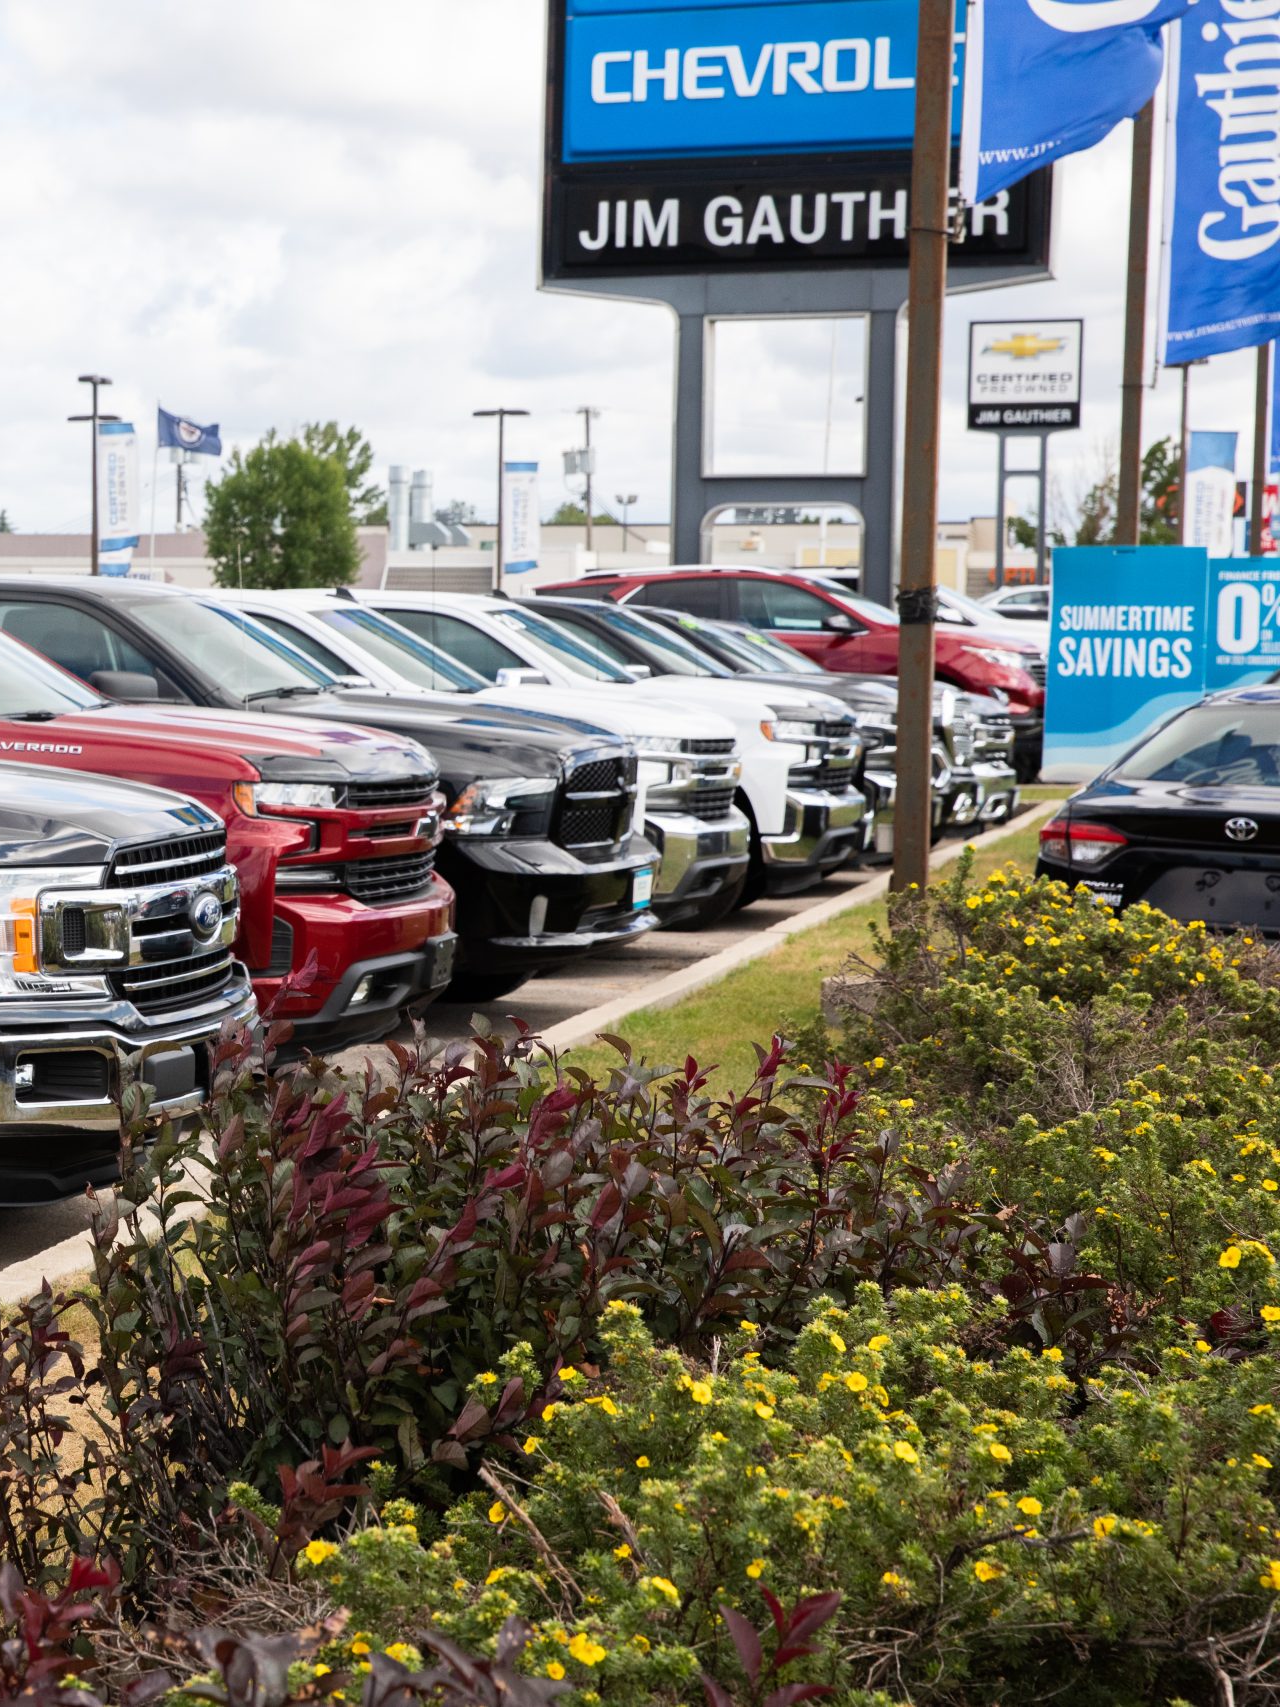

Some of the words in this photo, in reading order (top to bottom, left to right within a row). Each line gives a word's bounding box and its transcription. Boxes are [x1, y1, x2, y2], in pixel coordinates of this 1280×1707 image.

[591, 36, 965, 104] CHEVROL
[578, 199, 679, 251] JIM
[703, 187, 1010, 246] GAUTHER
[976, 372, 1073, 385] CERTIFIED
[975, 409, 1000, 425] JIM
[1003, 408, 1071, 424] GAUTHIER
[1059, 605, 1195, 632] SUMMERTIME
[1057, 636, 1193, 679] SAVINGS
